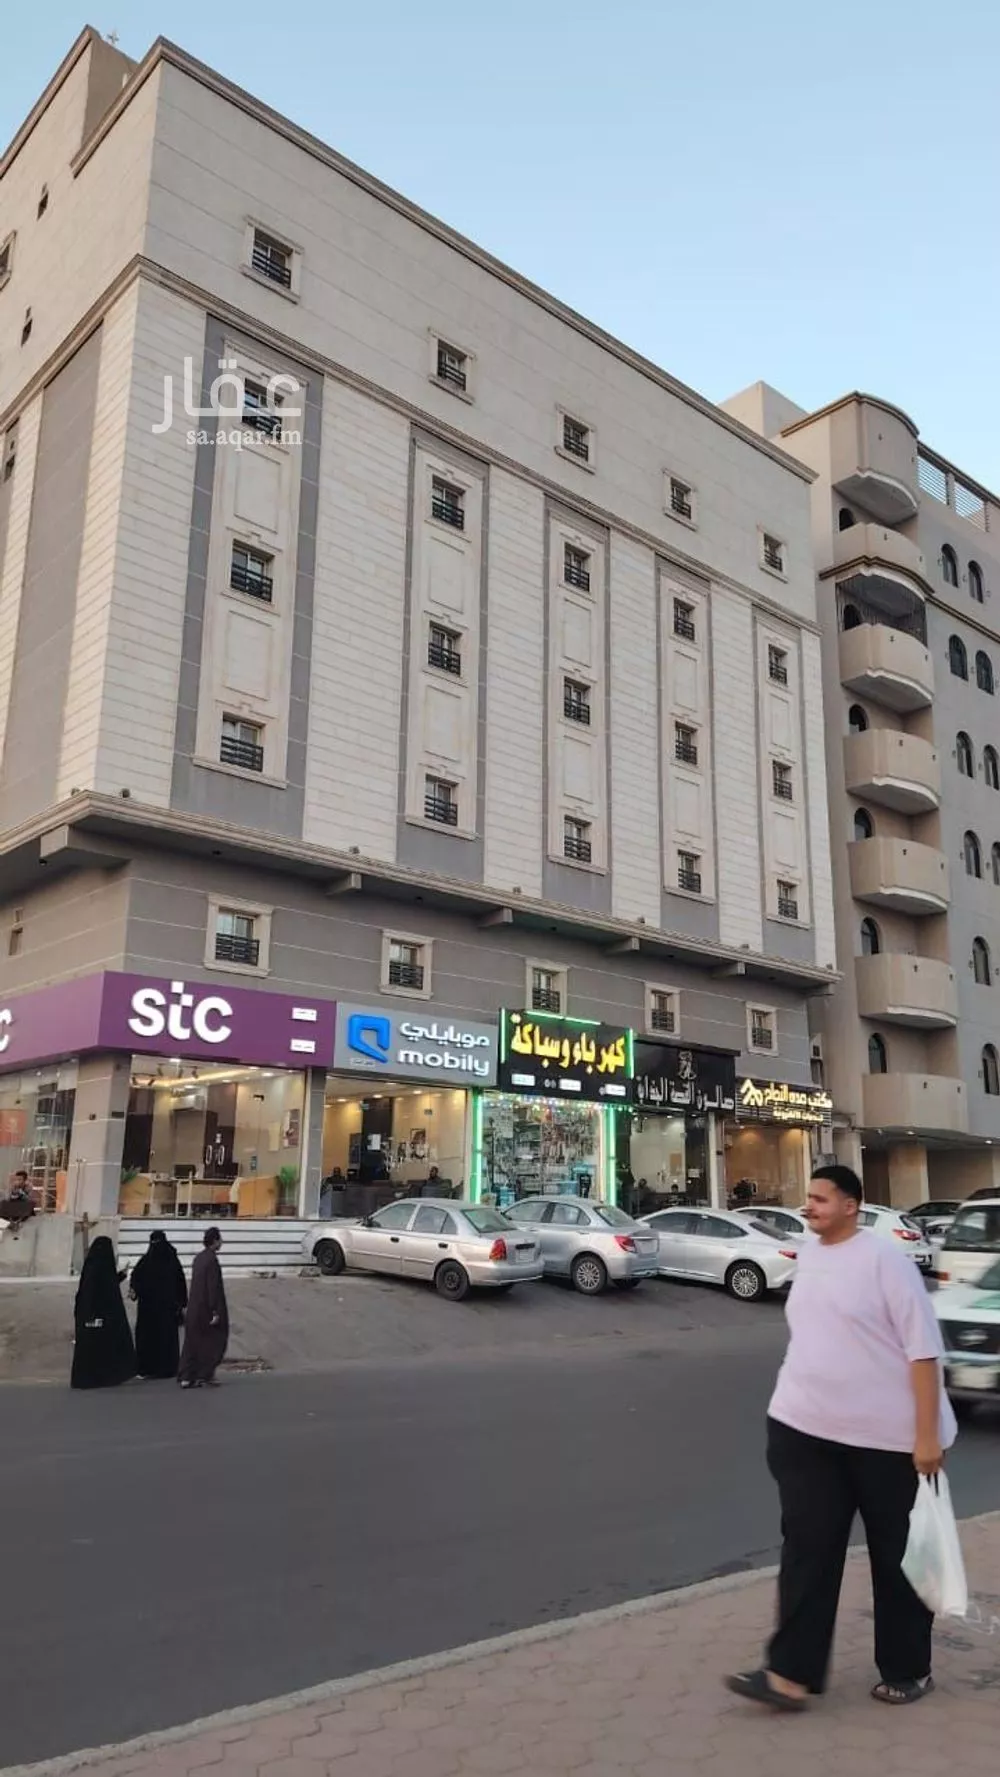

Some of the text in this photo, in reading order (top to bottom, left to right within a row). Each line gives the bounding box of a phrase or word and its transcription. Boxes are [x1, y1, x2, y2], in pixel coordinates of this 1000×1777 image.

[128, 981, 233, 1043] stc
[400, 1022, 490, 1048] موبايلي
[397, 1050, 490, 1076] mobily
[808, 1092, 833, 1111] مكتب
